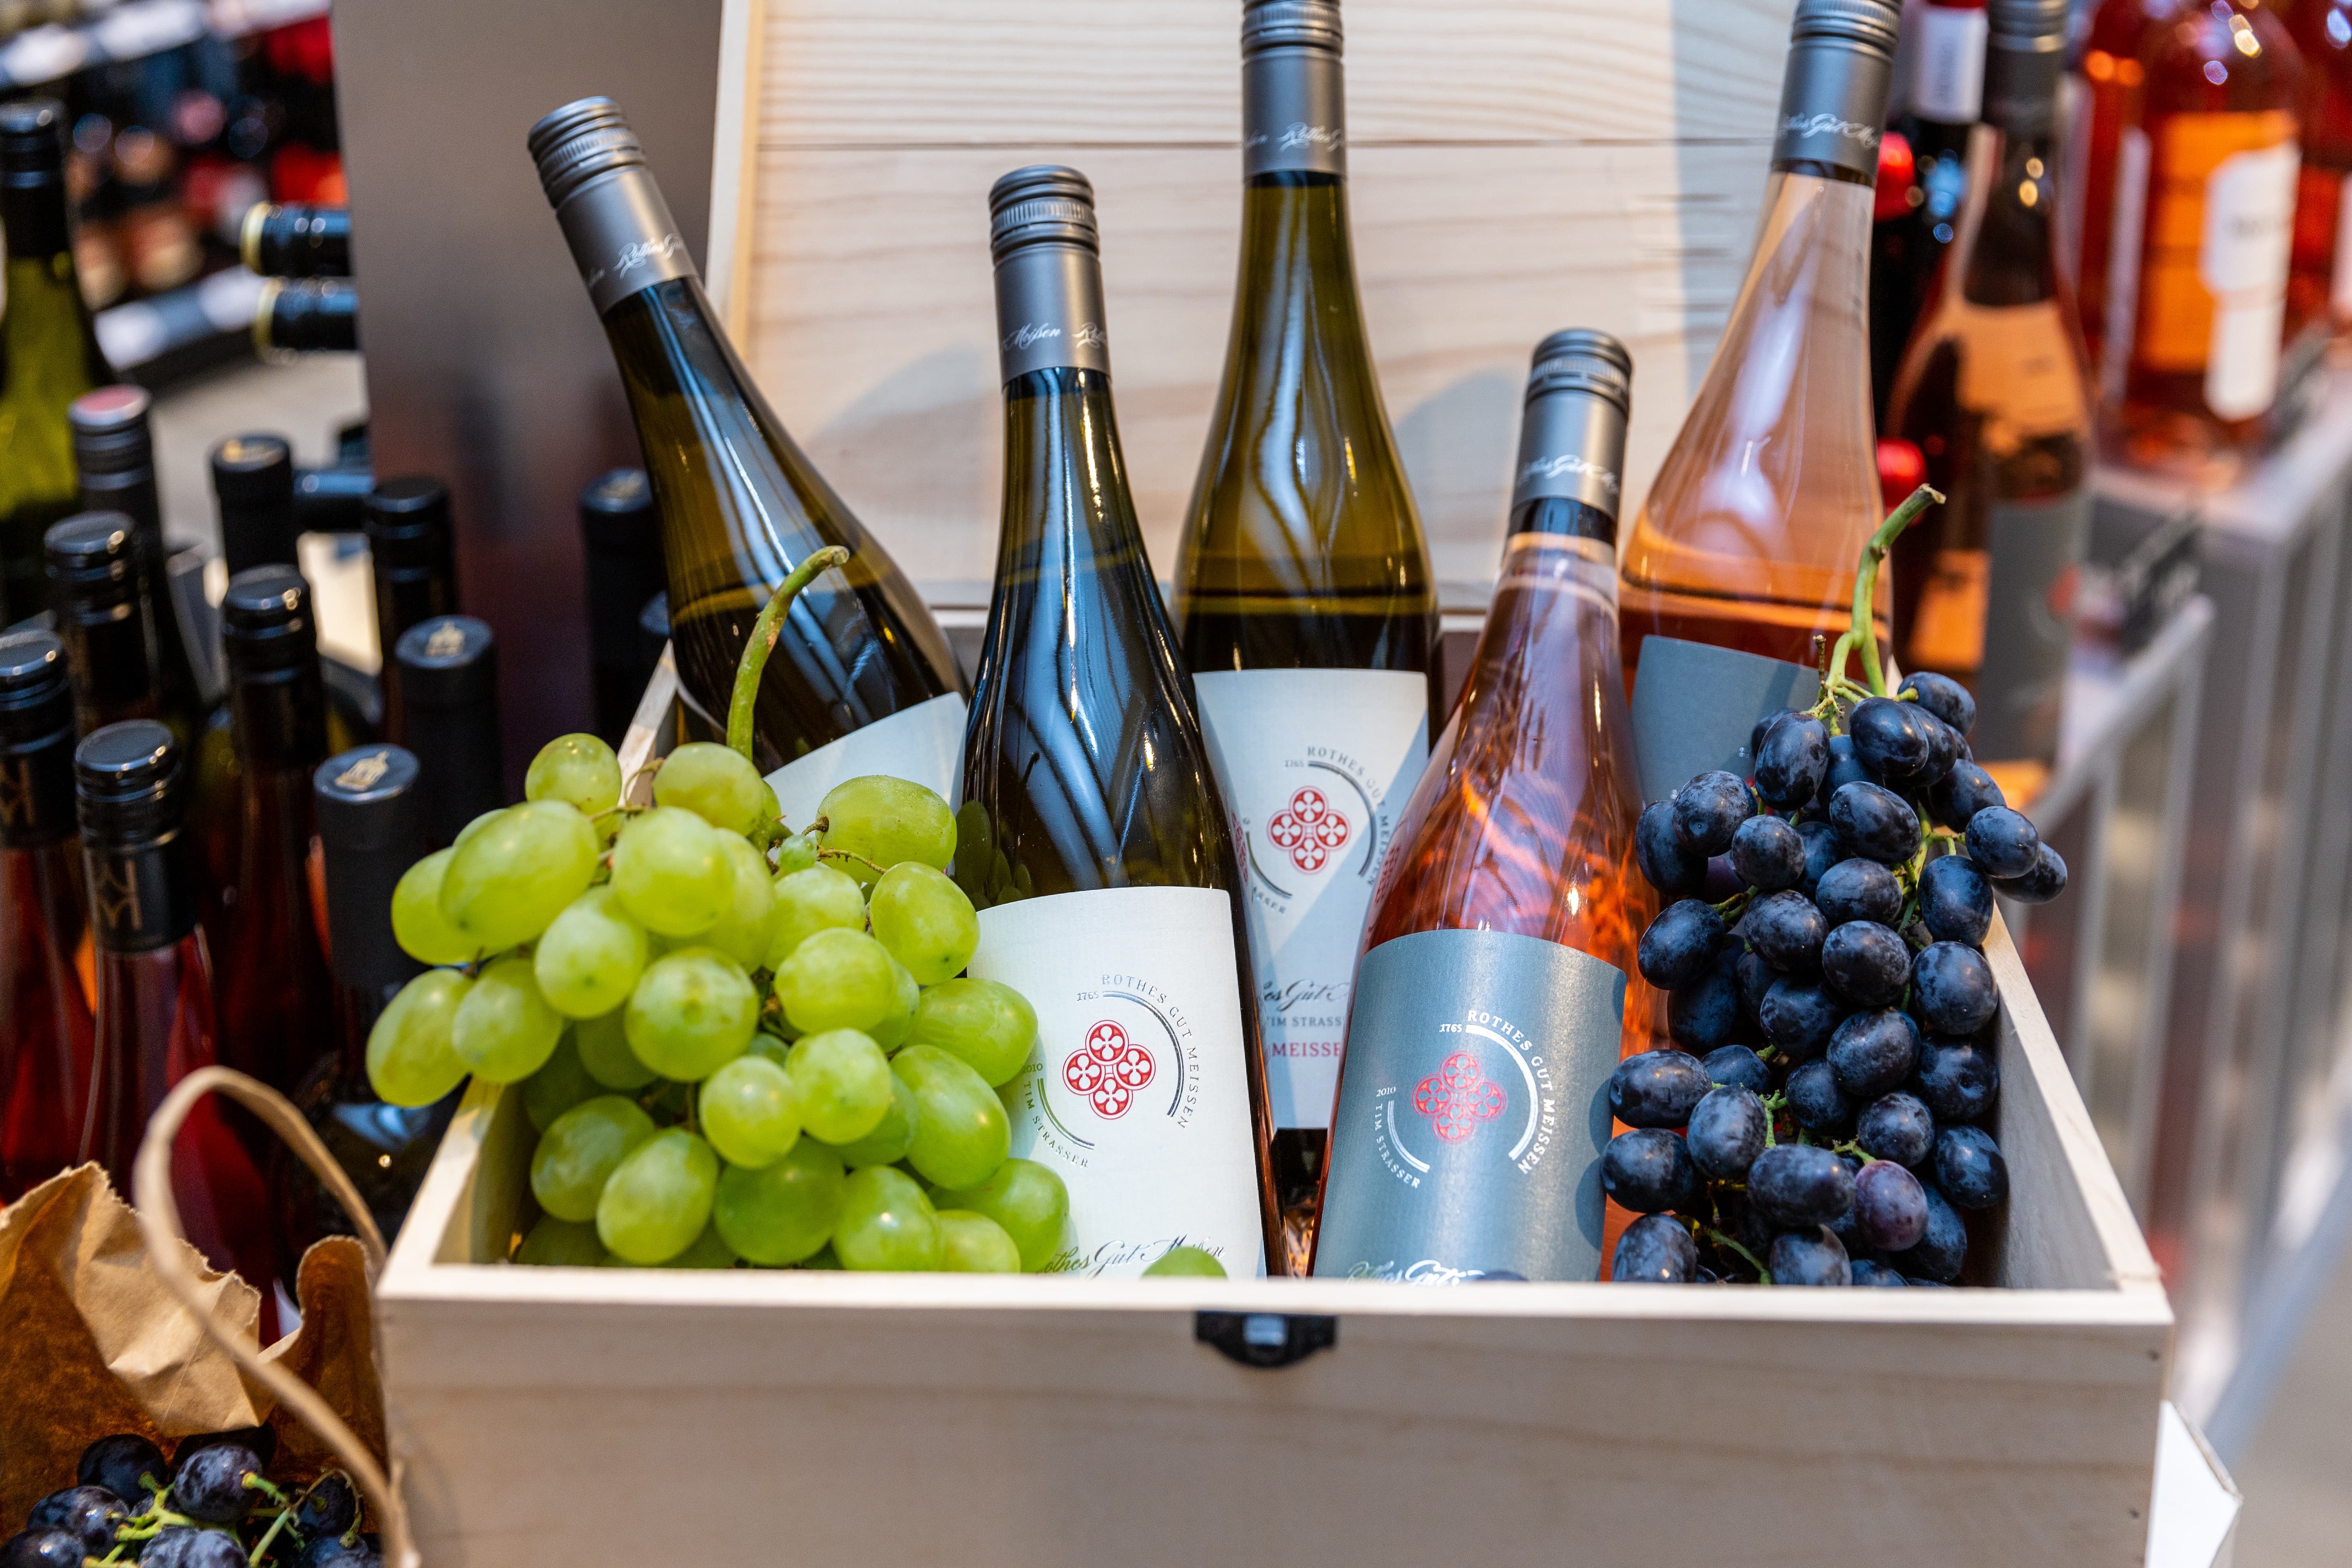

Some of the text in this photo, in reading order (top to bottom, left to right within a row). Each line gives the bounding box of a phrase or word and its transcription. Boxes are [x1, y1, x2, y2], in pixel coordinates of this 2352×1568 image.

[1307, 746, 1365, 776] ROTHES
[1366, 778, 1386, 807] GUT
[1077, 991, 1099, 1002] 1765
[1277, 979, 1334, 1012] Gut
[1266, 1016, 1344, 1027] IM STRASS
[1438, 1024, 1462, 1033] 1765
[1102, 974, 1199, 1129] ROTHES GUT MEISSEN
[1271, 1042, 1341, 1057] MEISSE
[1022, 1063, 1043, 1074] 2010
[1376, 1086, 1396, 1097] 2010
[1467, 1010, 1556, 1175] ROTHES GUT MEISSEN
[1024, 1081, 1089, 1168] TIM STRASSER
[1375, 1103, 1421, 1189] TIM STRASSER
[1036, 1246, 1092, 1274] othes
[1086, 1239, 1150, 1281] Gut
